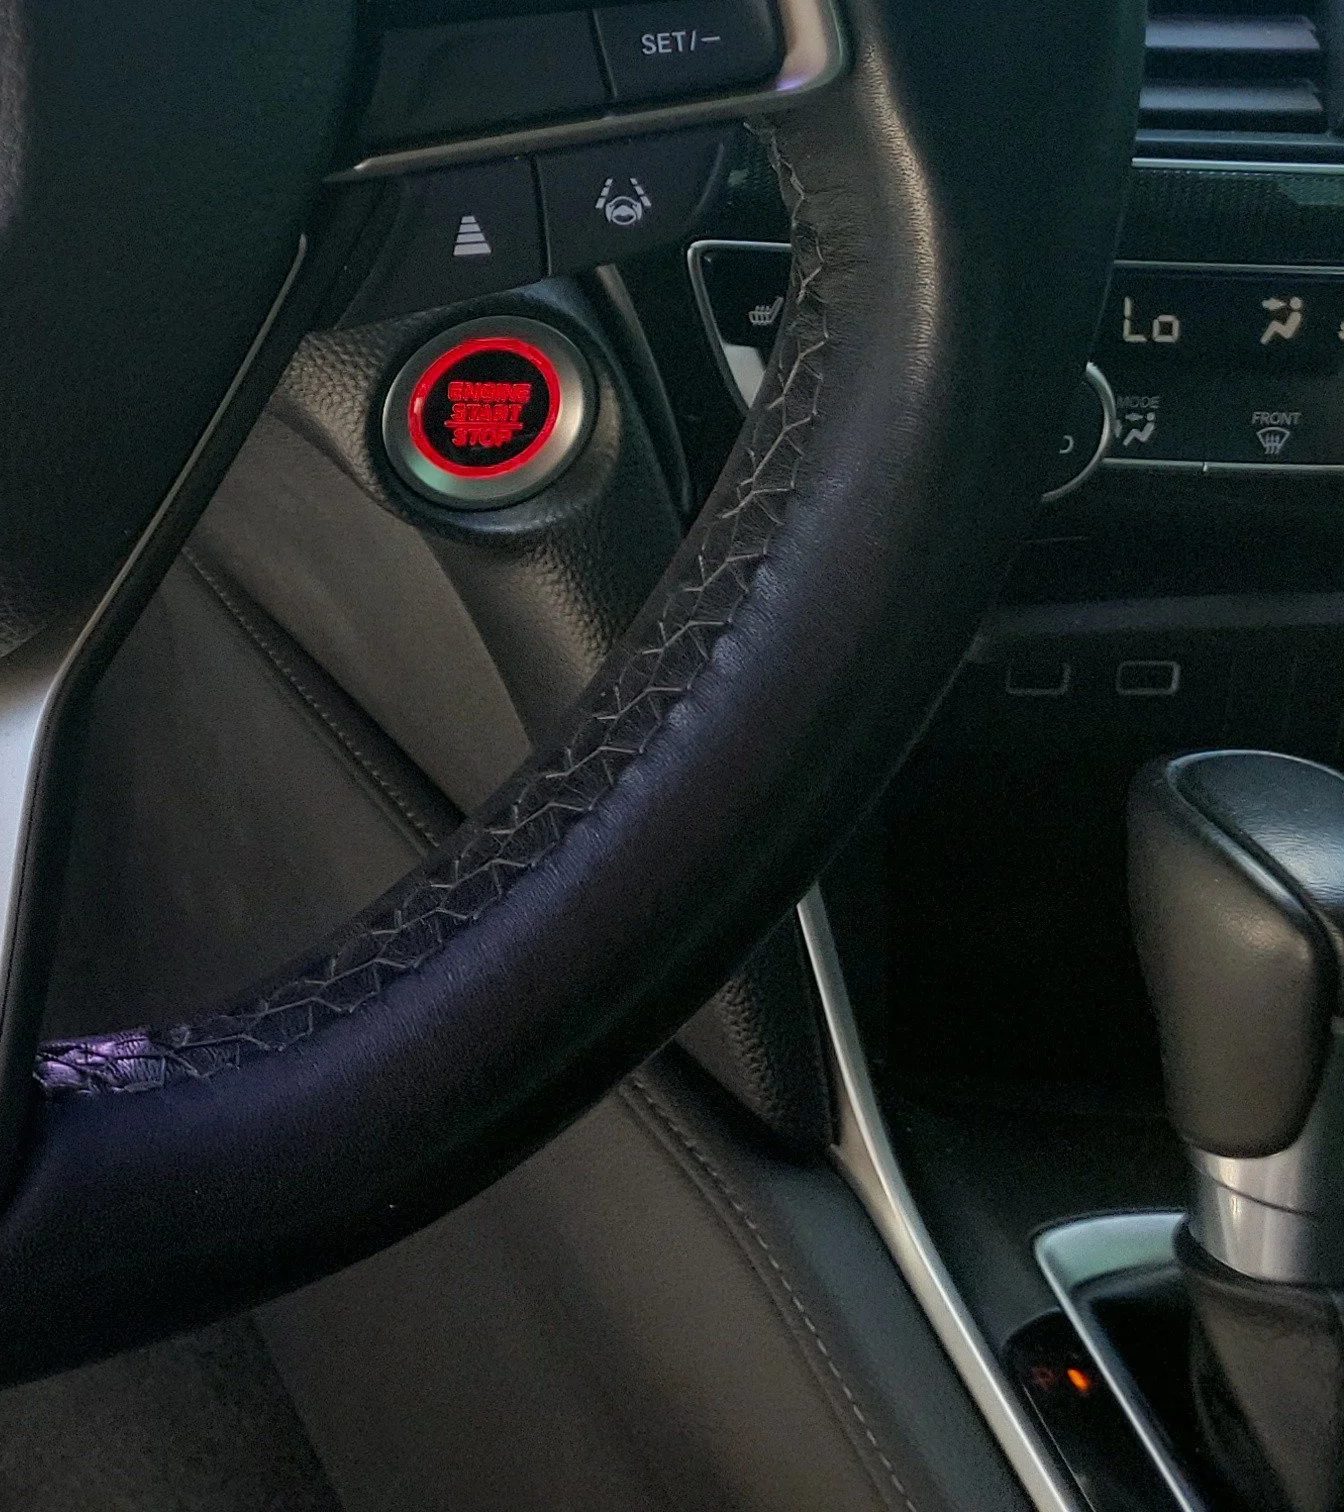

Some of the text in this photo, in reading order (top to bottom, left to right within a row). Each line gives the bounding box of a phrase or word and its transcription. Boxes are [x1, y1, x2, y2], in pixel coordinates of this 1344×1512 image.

[1123, 296, 1181, 343] Lo
[447, 381, 533, 403] ENGINE
[1116, 396, 1160, 409] MODE
[451, 403, 523, 422] START
[1251, 411, 1302, 425] FRONT
[452, 428, 512, 447] STOP
